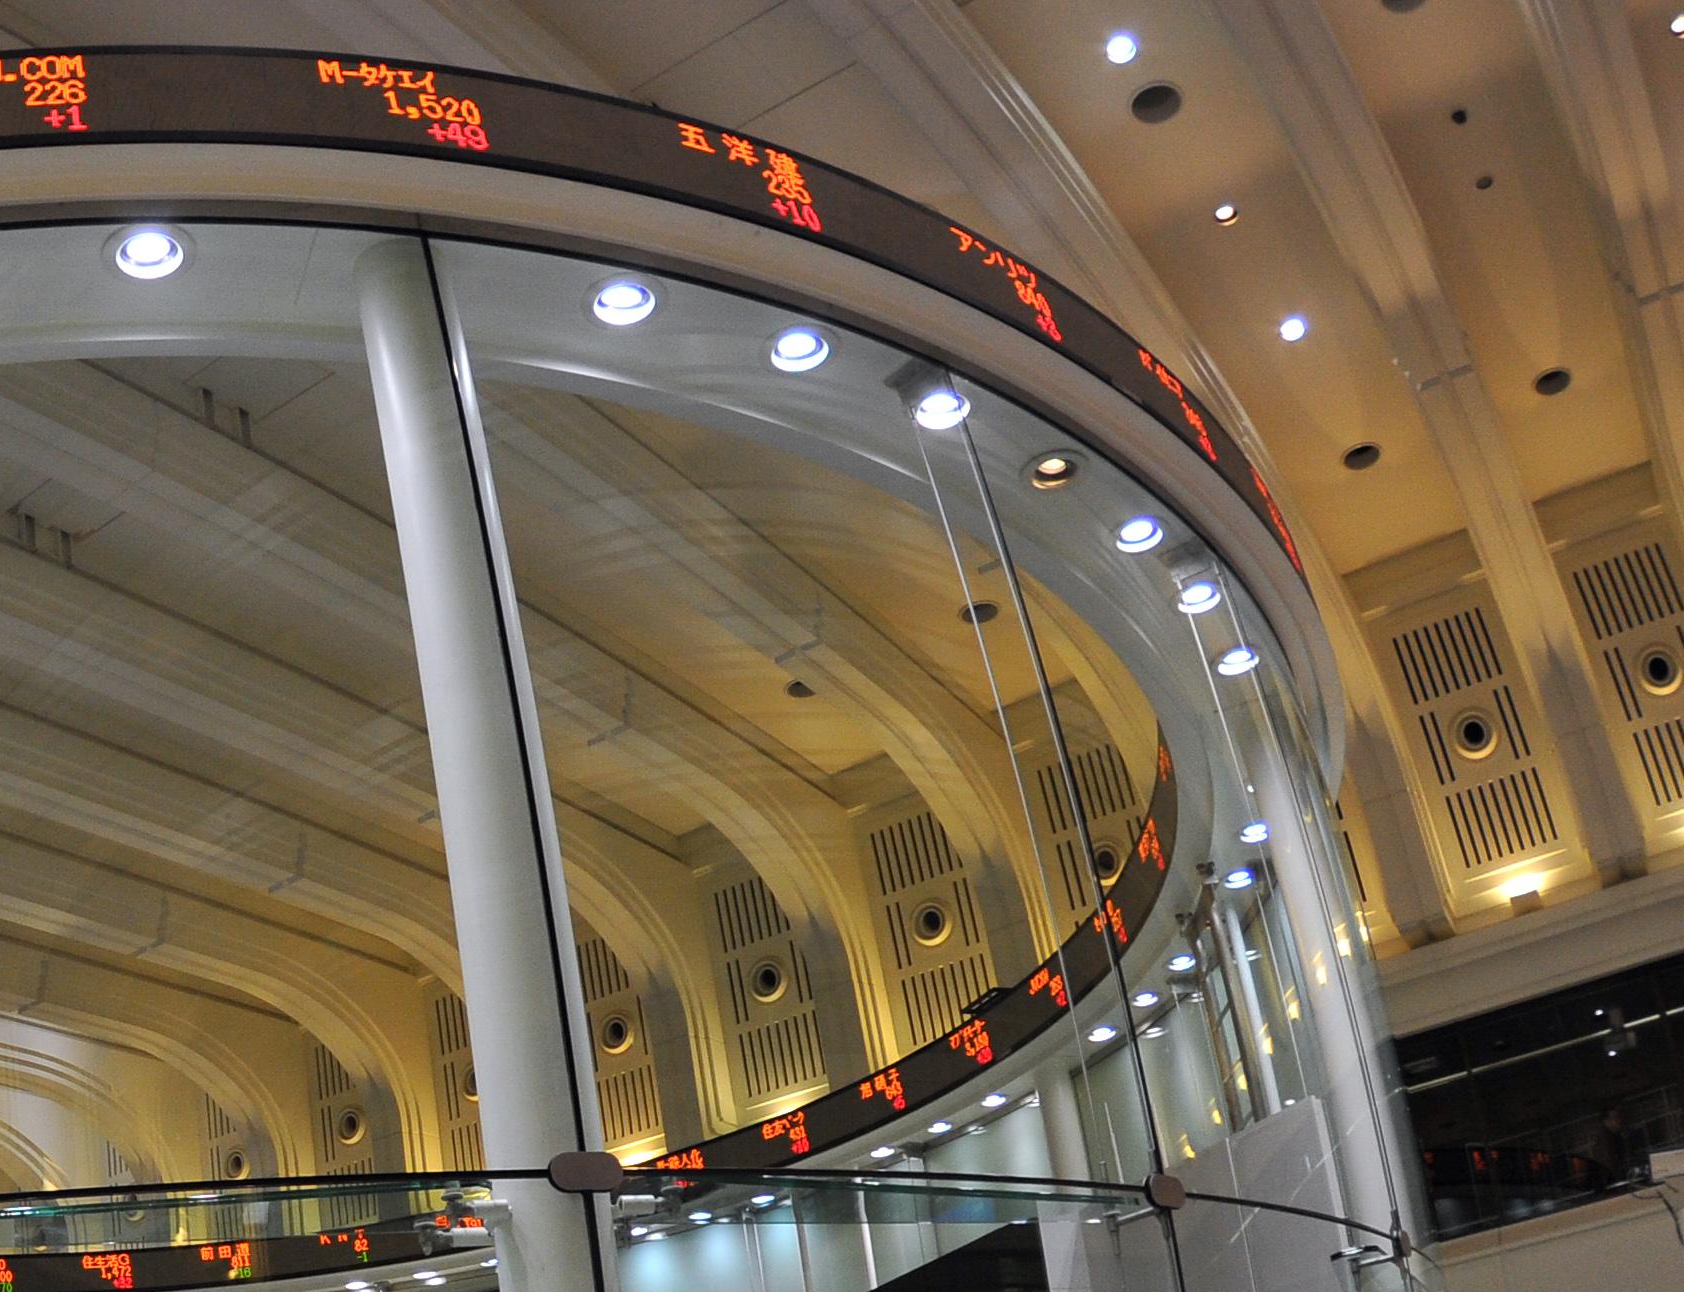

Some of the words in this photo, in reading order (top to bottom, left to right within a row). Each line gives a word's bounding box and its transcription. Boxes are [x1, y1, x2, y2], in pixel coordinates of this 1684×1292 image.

[23, 79, 88, 107] 226
[383, 90, 482, 126] 1,520
[43, 104, 89, 132] +1
[427, 122, 490, 152] +49
[772, 197, 823, 233] +10
